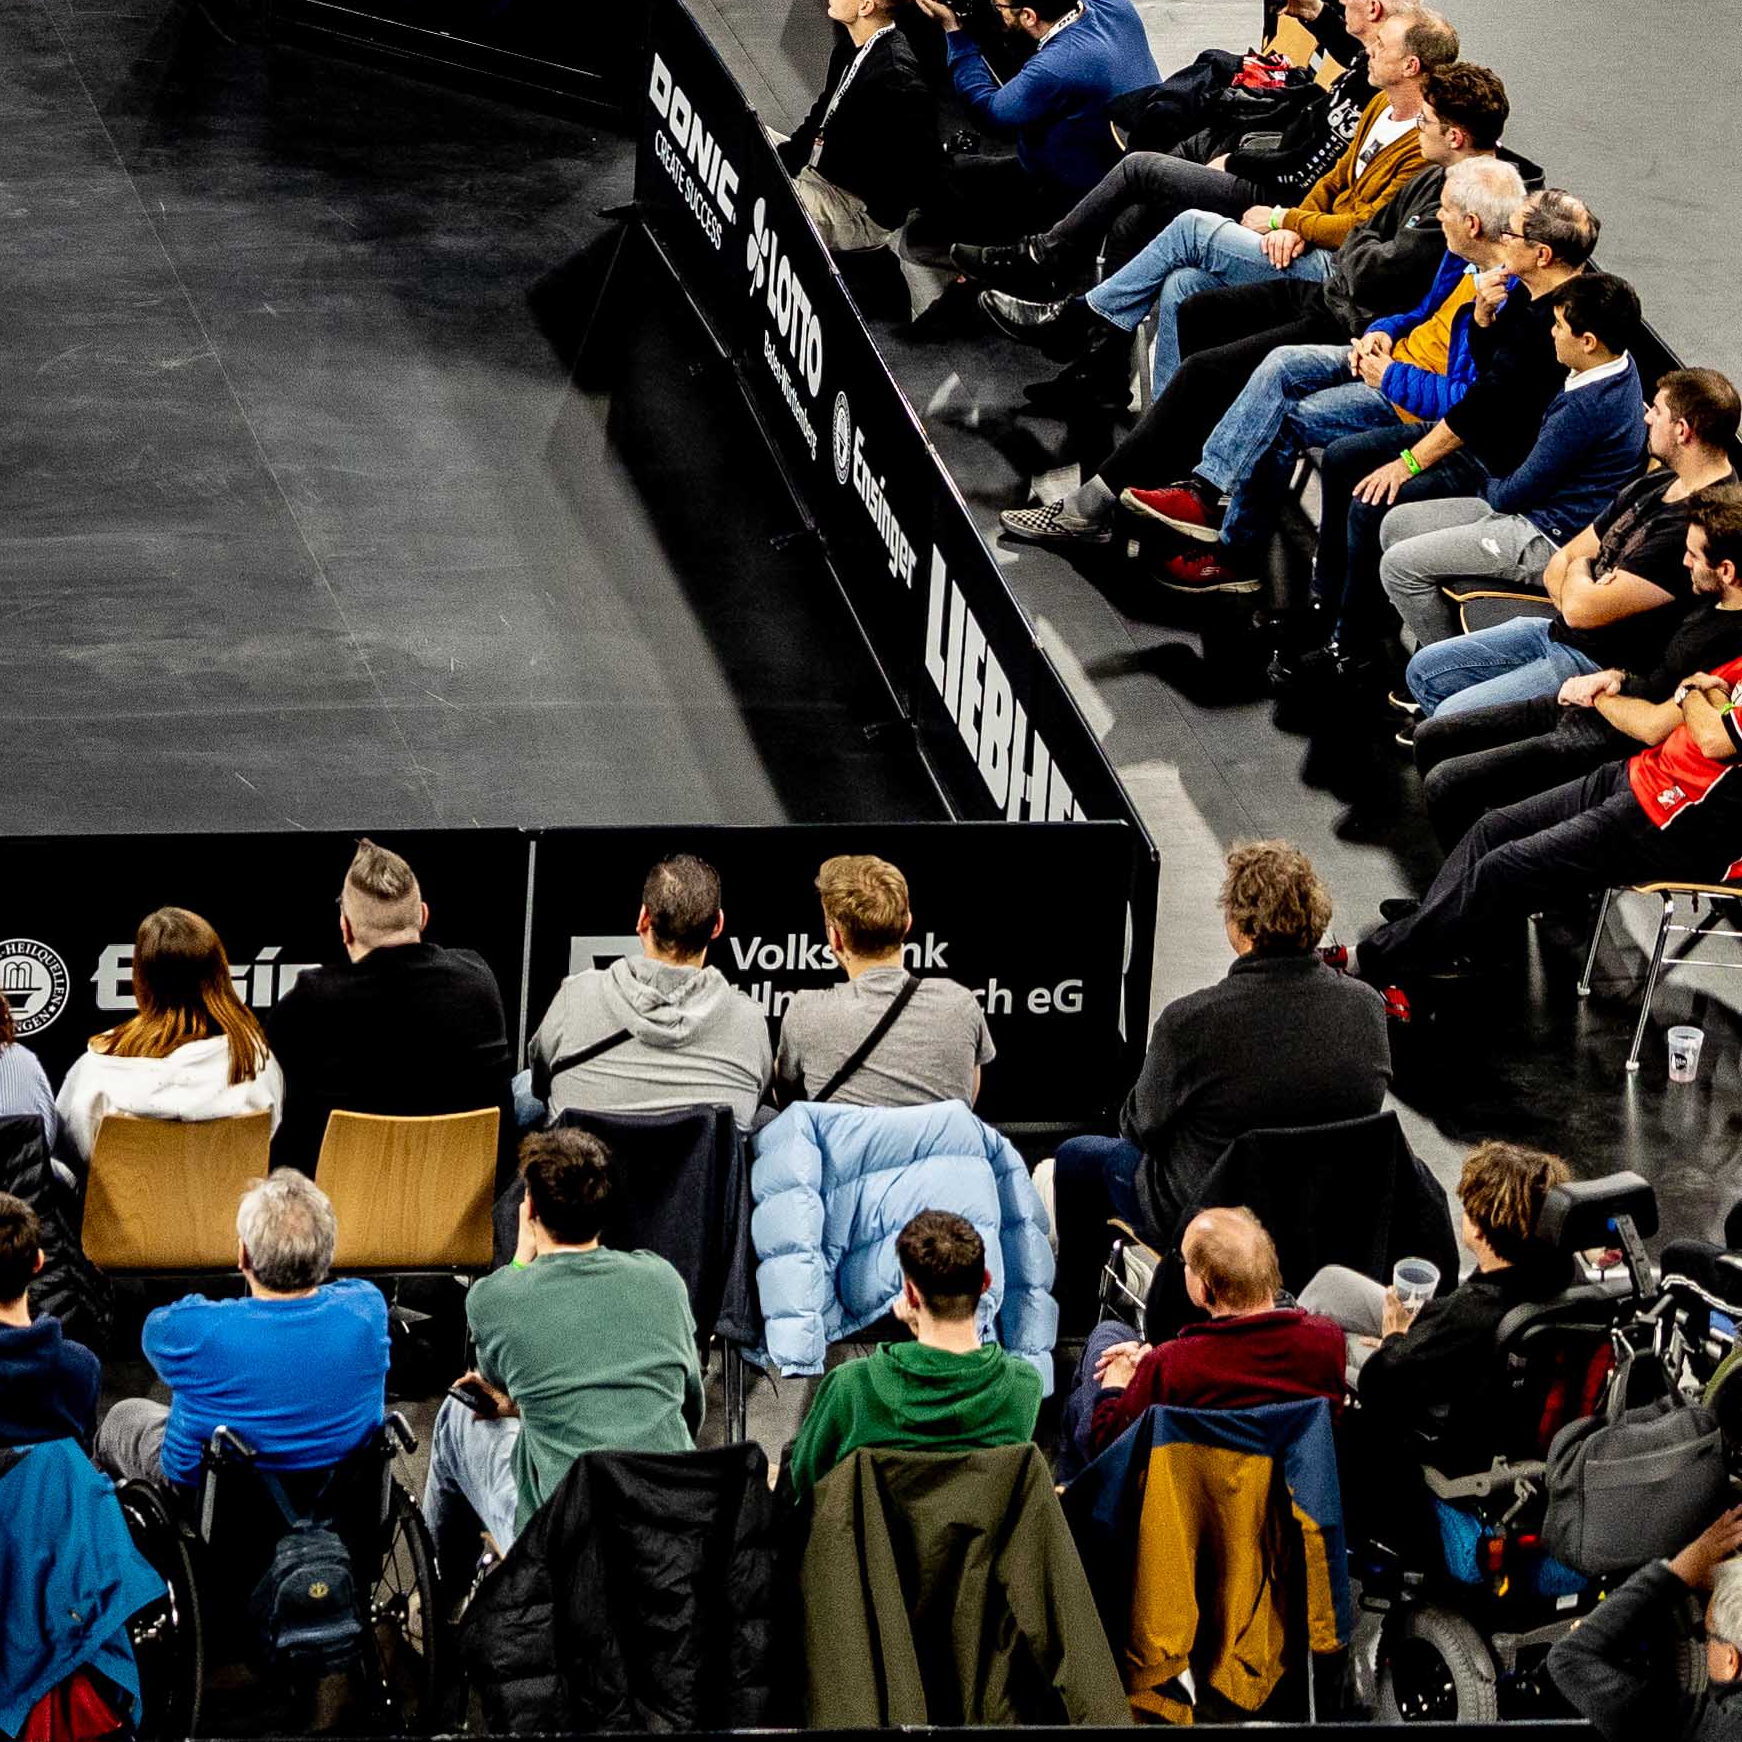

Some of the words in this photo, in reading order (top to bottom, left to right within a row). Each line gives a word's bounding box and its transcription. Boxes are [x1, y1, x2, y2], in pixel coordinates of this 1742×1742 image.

[648, 52, 740, 224] DONIC
[654, 128, 685, 194] CREATE
[684, 179, 723, 251] SUCCESS
[766, 229, 824, 399] LOTTO
[763, 329, 818, 461] Baden-Württemberg
[852, 425, 918, 590] Ensinger
[925, 543, 1088, 823] LIEBH
[729, 932, 950, 971] Volksnk
[1026, 978, 1084, 1014] eG
